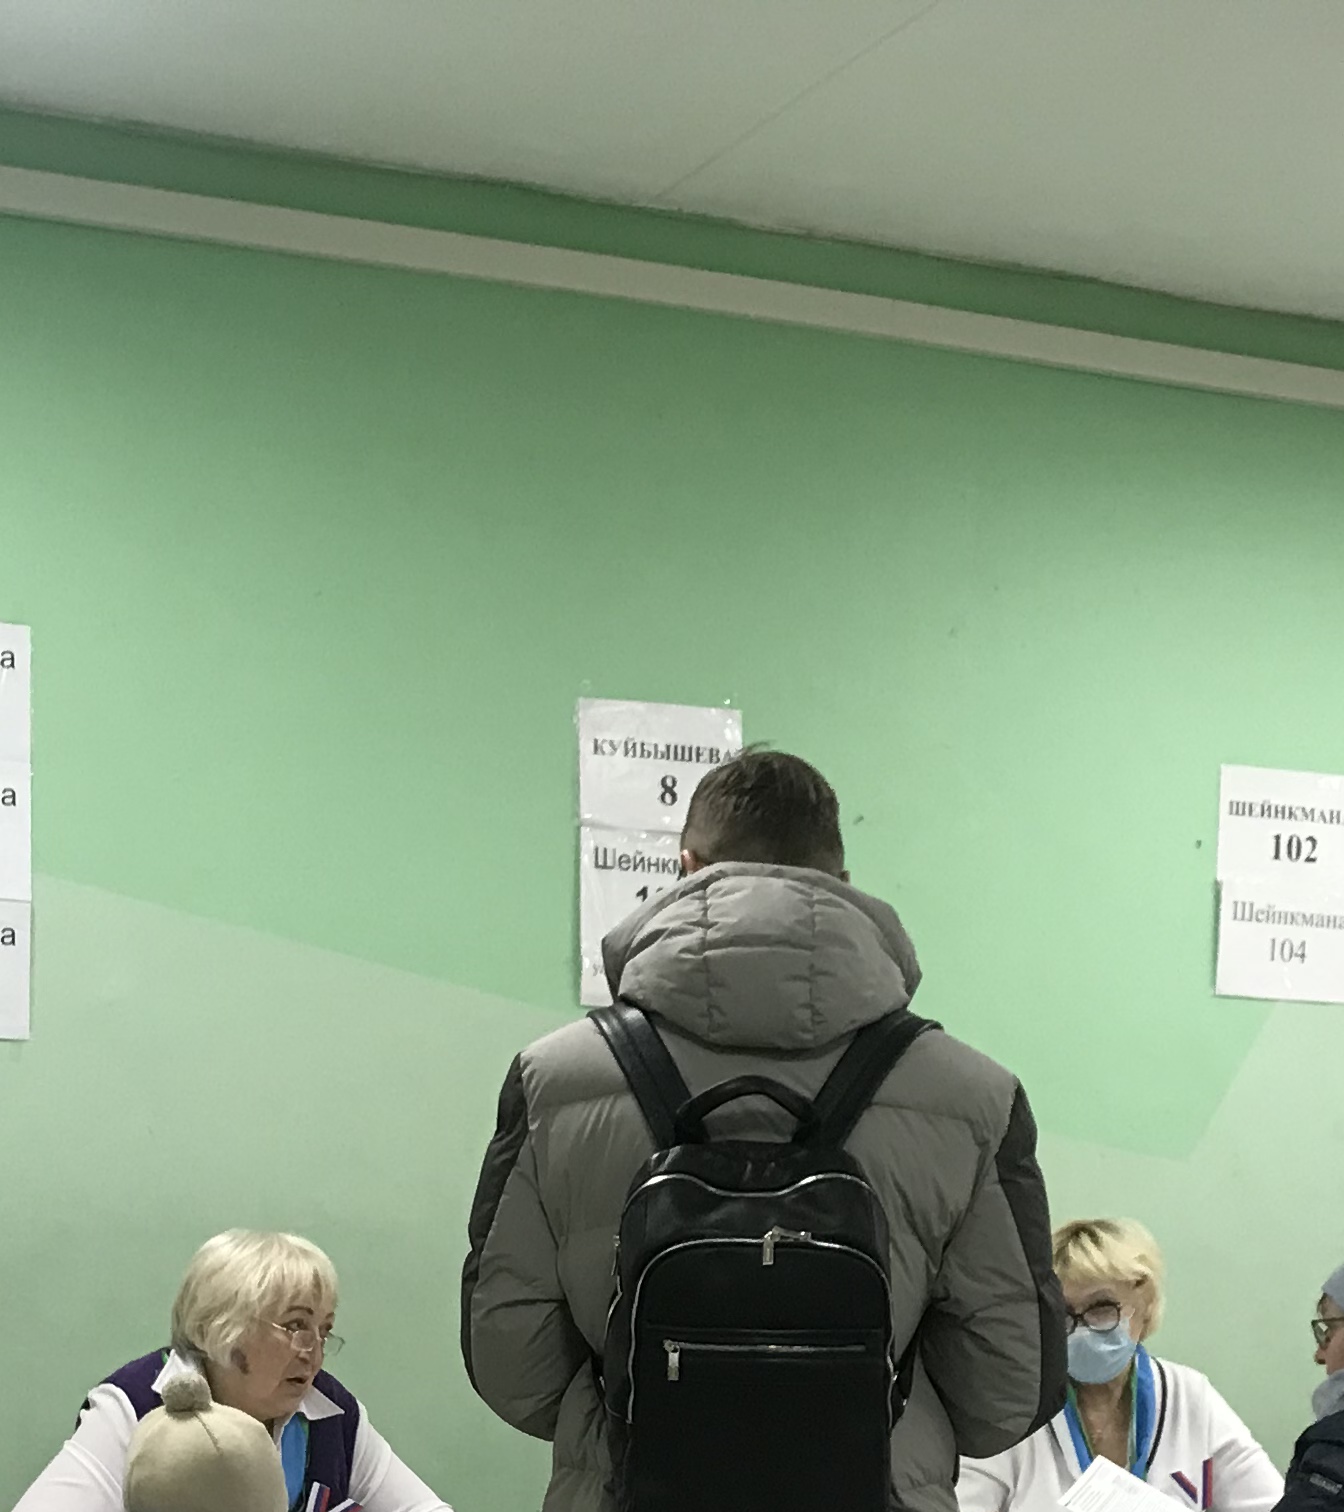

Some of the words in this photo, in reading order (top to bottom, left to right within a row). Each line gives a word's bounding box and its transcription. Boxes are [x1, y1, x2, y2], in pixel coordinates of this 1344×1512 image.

[660, 774, 678, 806] 8
[1271, 833, 1319, 863] 102
[1269, 937, 1307, 964] 104
